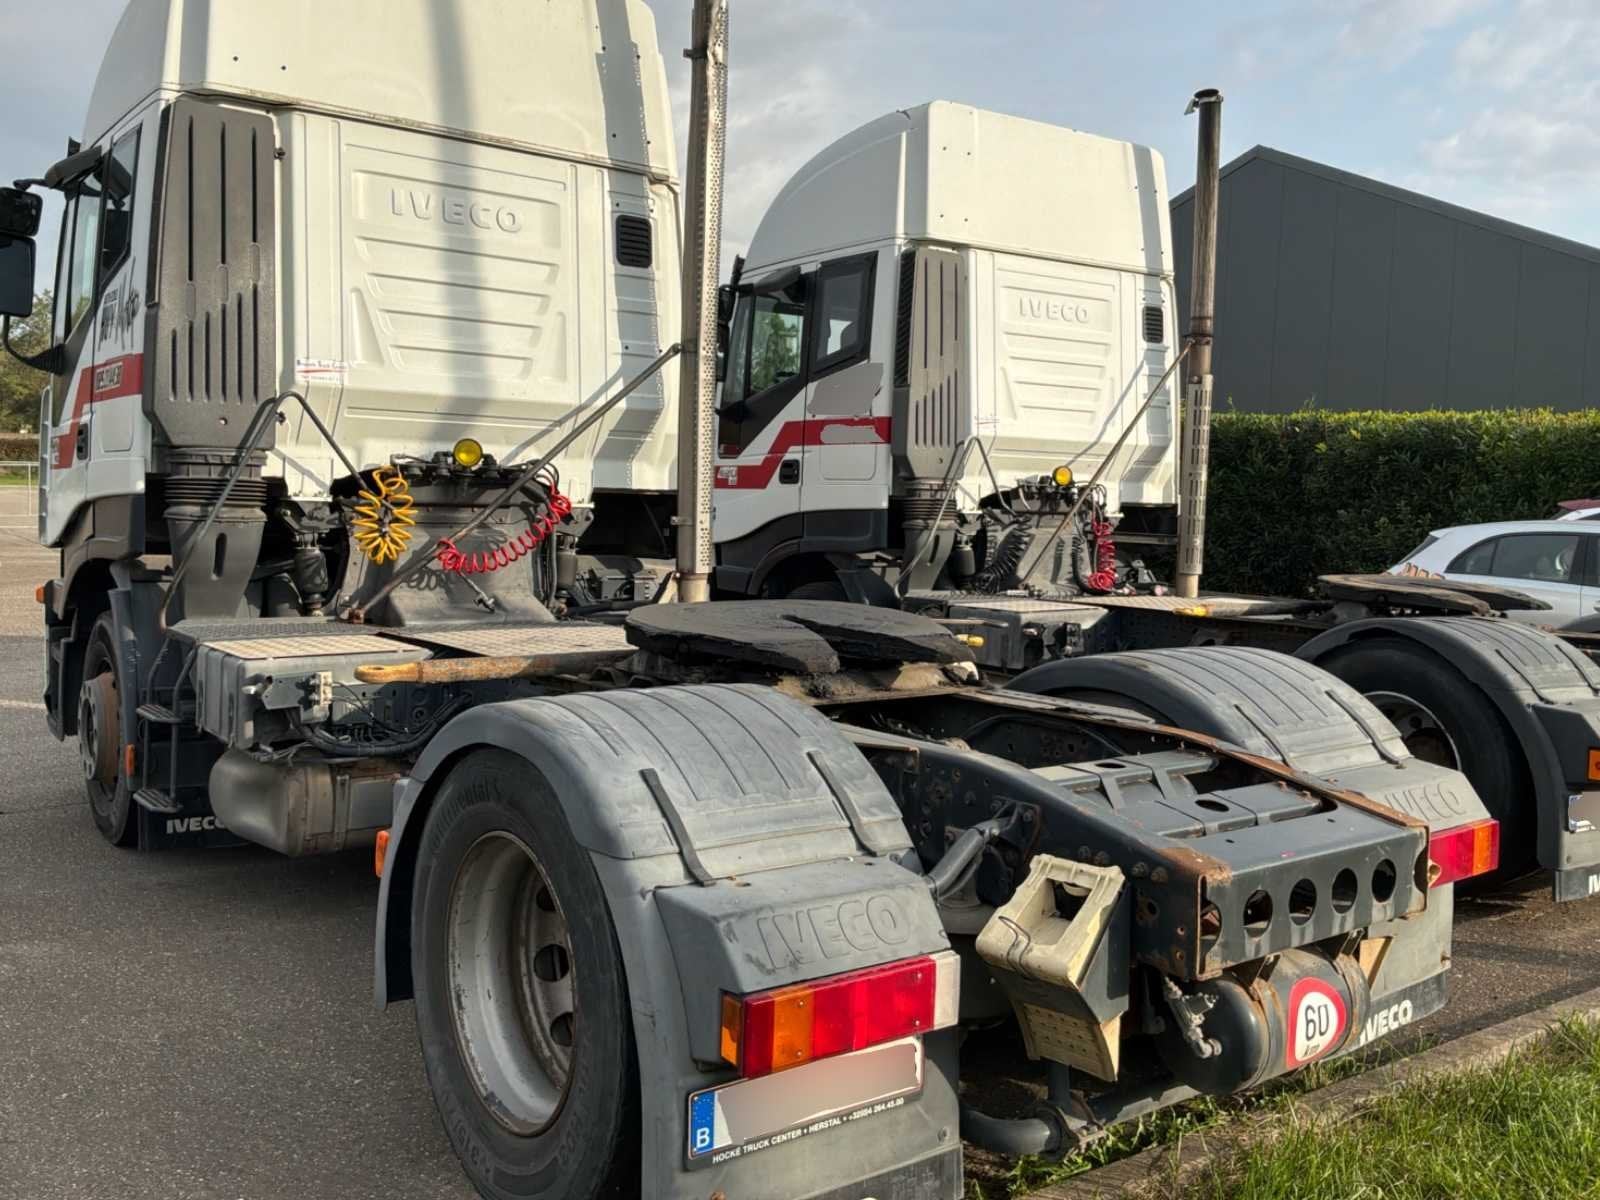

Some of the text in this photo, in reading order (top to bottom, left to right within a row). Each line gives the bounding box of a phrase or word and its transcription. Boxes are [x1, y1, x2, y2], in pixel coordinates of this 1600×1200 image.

[390, 186, 523, 234] IVECO
[1018, 296, 1090, 324] IVECO
[756, 894, 911, 970] IVECO
[1304, 1003, 1330, 1042] 60
[696, 1127, 710, 1148] B
[742, 1140, 770, 1154] TRUCK
[771, 1128, 802, 1145] CENTER
[808, 1117, 842, 1134] HERSTAL
